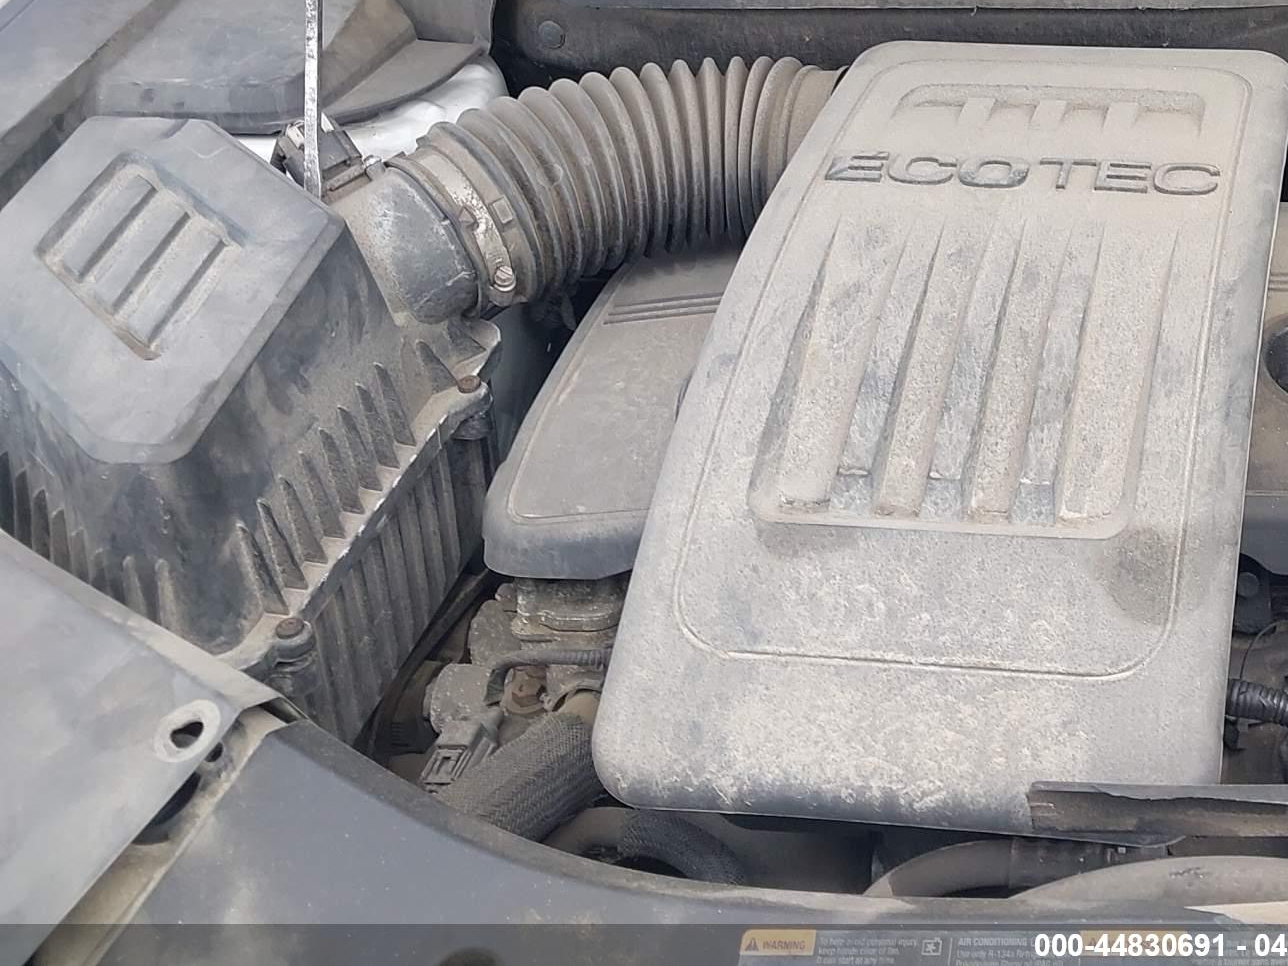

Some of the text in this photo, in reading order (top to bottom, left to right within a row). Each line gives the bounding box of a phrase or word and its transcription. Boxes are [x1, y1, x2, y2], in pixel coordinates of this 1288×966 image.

[825, 151, 1221, 195] ECOTEC
[762, 940, 806, 951] WARNING
[958, 938, 1028, 947] AIR CONDITIONING
